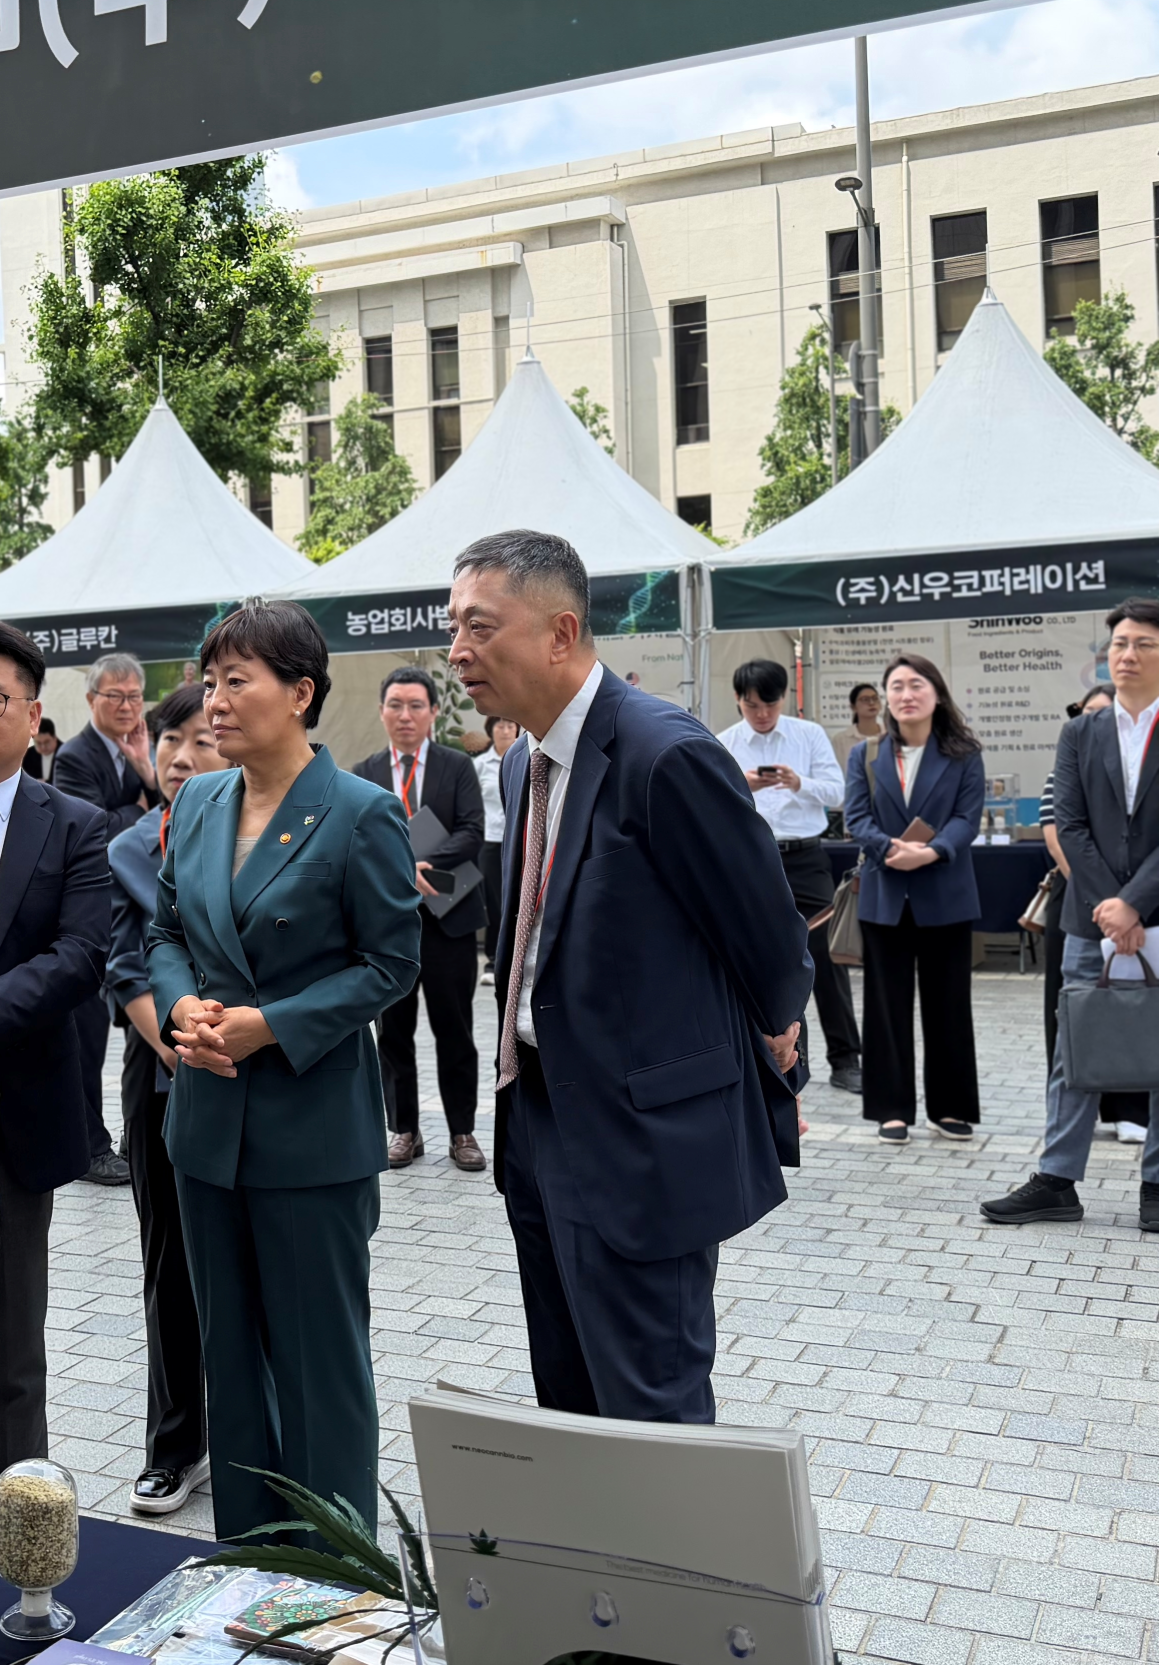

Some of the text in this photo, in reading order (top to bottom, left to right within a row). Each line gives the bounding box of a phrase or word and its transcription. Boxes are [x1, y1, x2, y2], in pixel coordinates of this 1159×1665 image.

[835, 560, 1107, 607] (주)신우코퍼레이션
[1062, 616, 1076, 624] LTD
[642, 654, 666, 663] From
[979, 648, 1063, 660] Better Origins,
[983, 660, 1062, 673] Better Health
[451, 1444, 534, 1462] www.neocannbio.com
[646, 1567, 687, 1581] medicine
[688, 1573, 701, 1583] for
